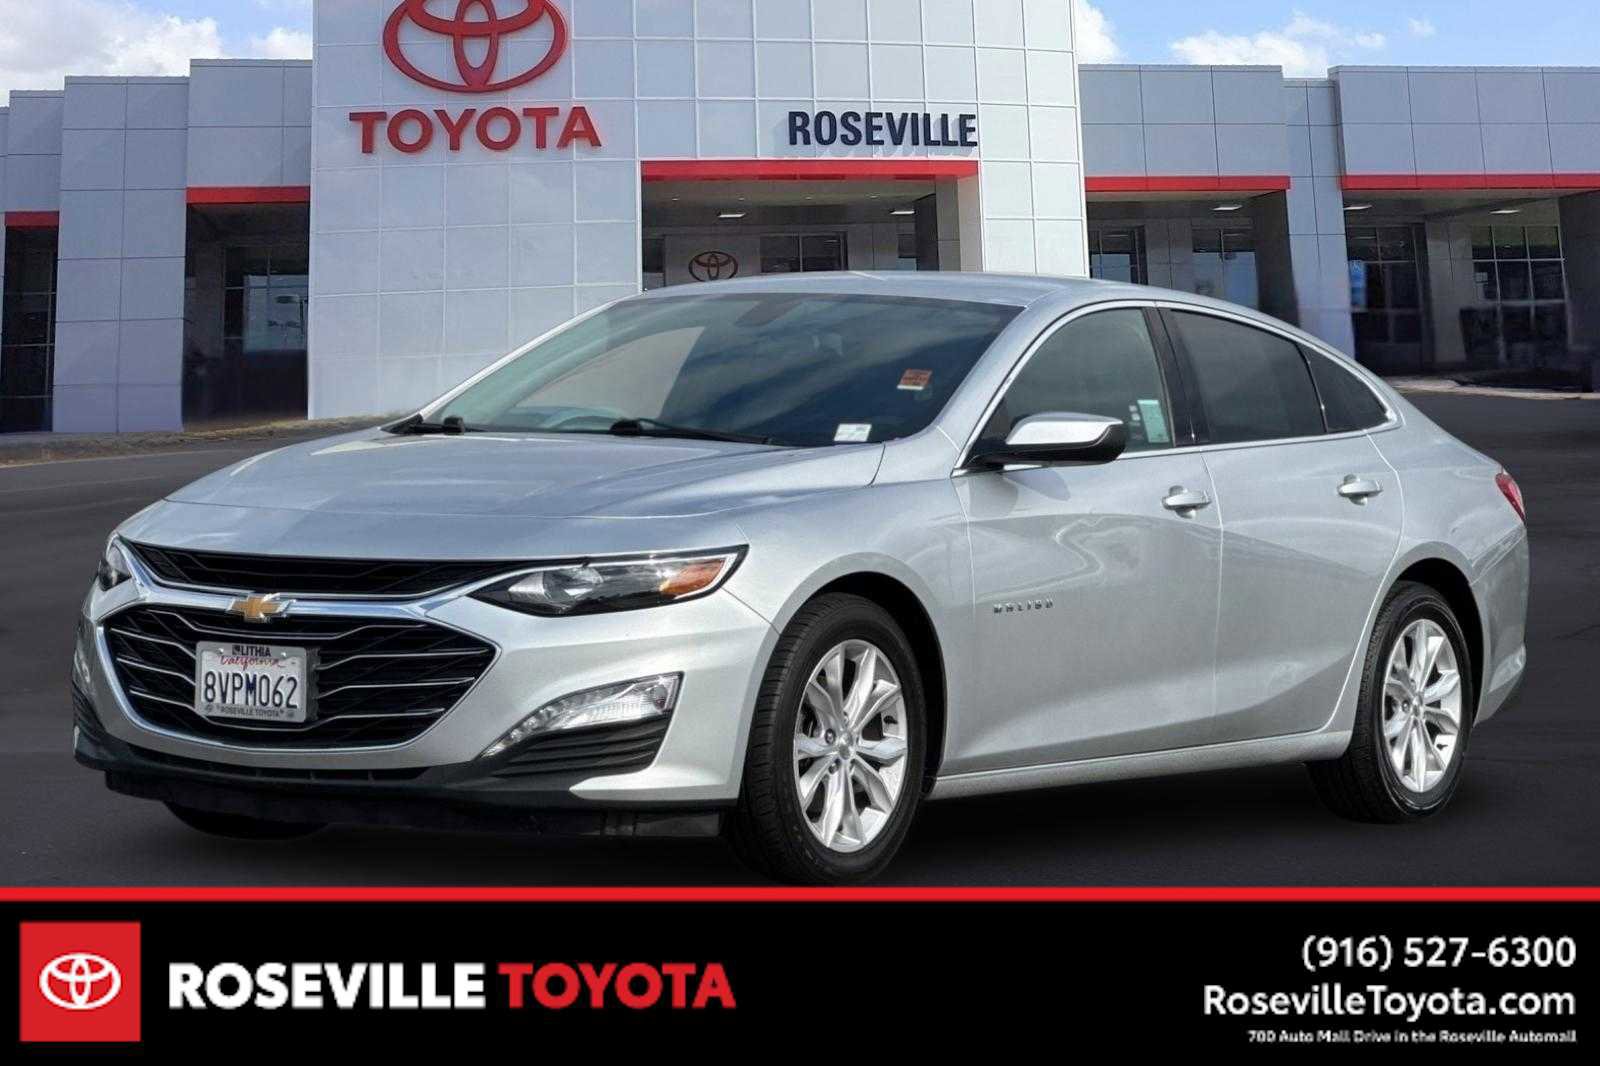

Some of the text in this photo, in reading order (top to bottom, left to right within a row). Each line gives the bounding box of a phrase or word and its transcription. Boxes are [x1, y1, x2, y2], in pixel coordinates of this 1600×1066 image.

[349, 106, 602, 154] TOYOTA
[788, 111, 978, 146] ROSEVILLE
[220, 656, 284, 671] California
[241, 645, 271, 657] LITHIA
[205, 671, 298, 709] 8VPM062
[255, 708, 280, 718] TOYOTA
